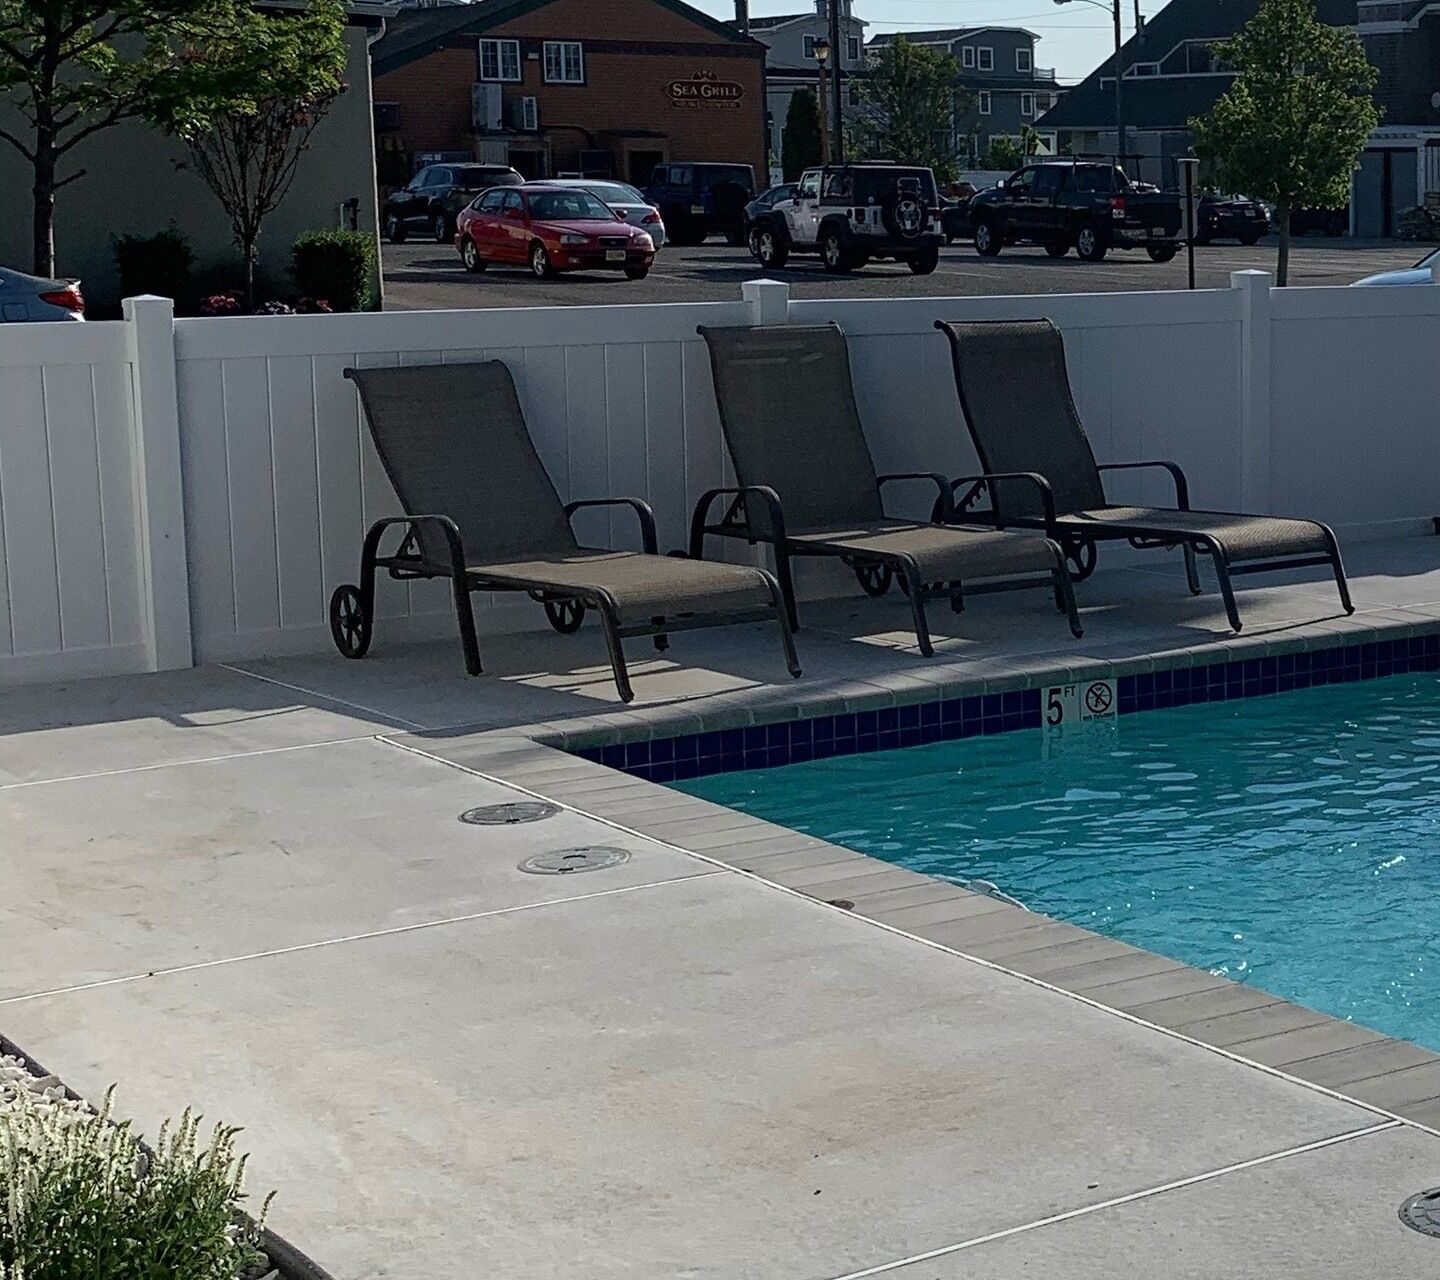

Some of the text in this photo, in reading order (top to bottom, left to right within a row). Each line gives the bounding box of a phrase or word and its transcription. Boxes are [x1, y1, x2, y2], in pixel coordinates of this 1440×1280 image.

[672, 83, 738, 97] SEA GRILL
[1046, 685, 1076, 726] 5 FT
